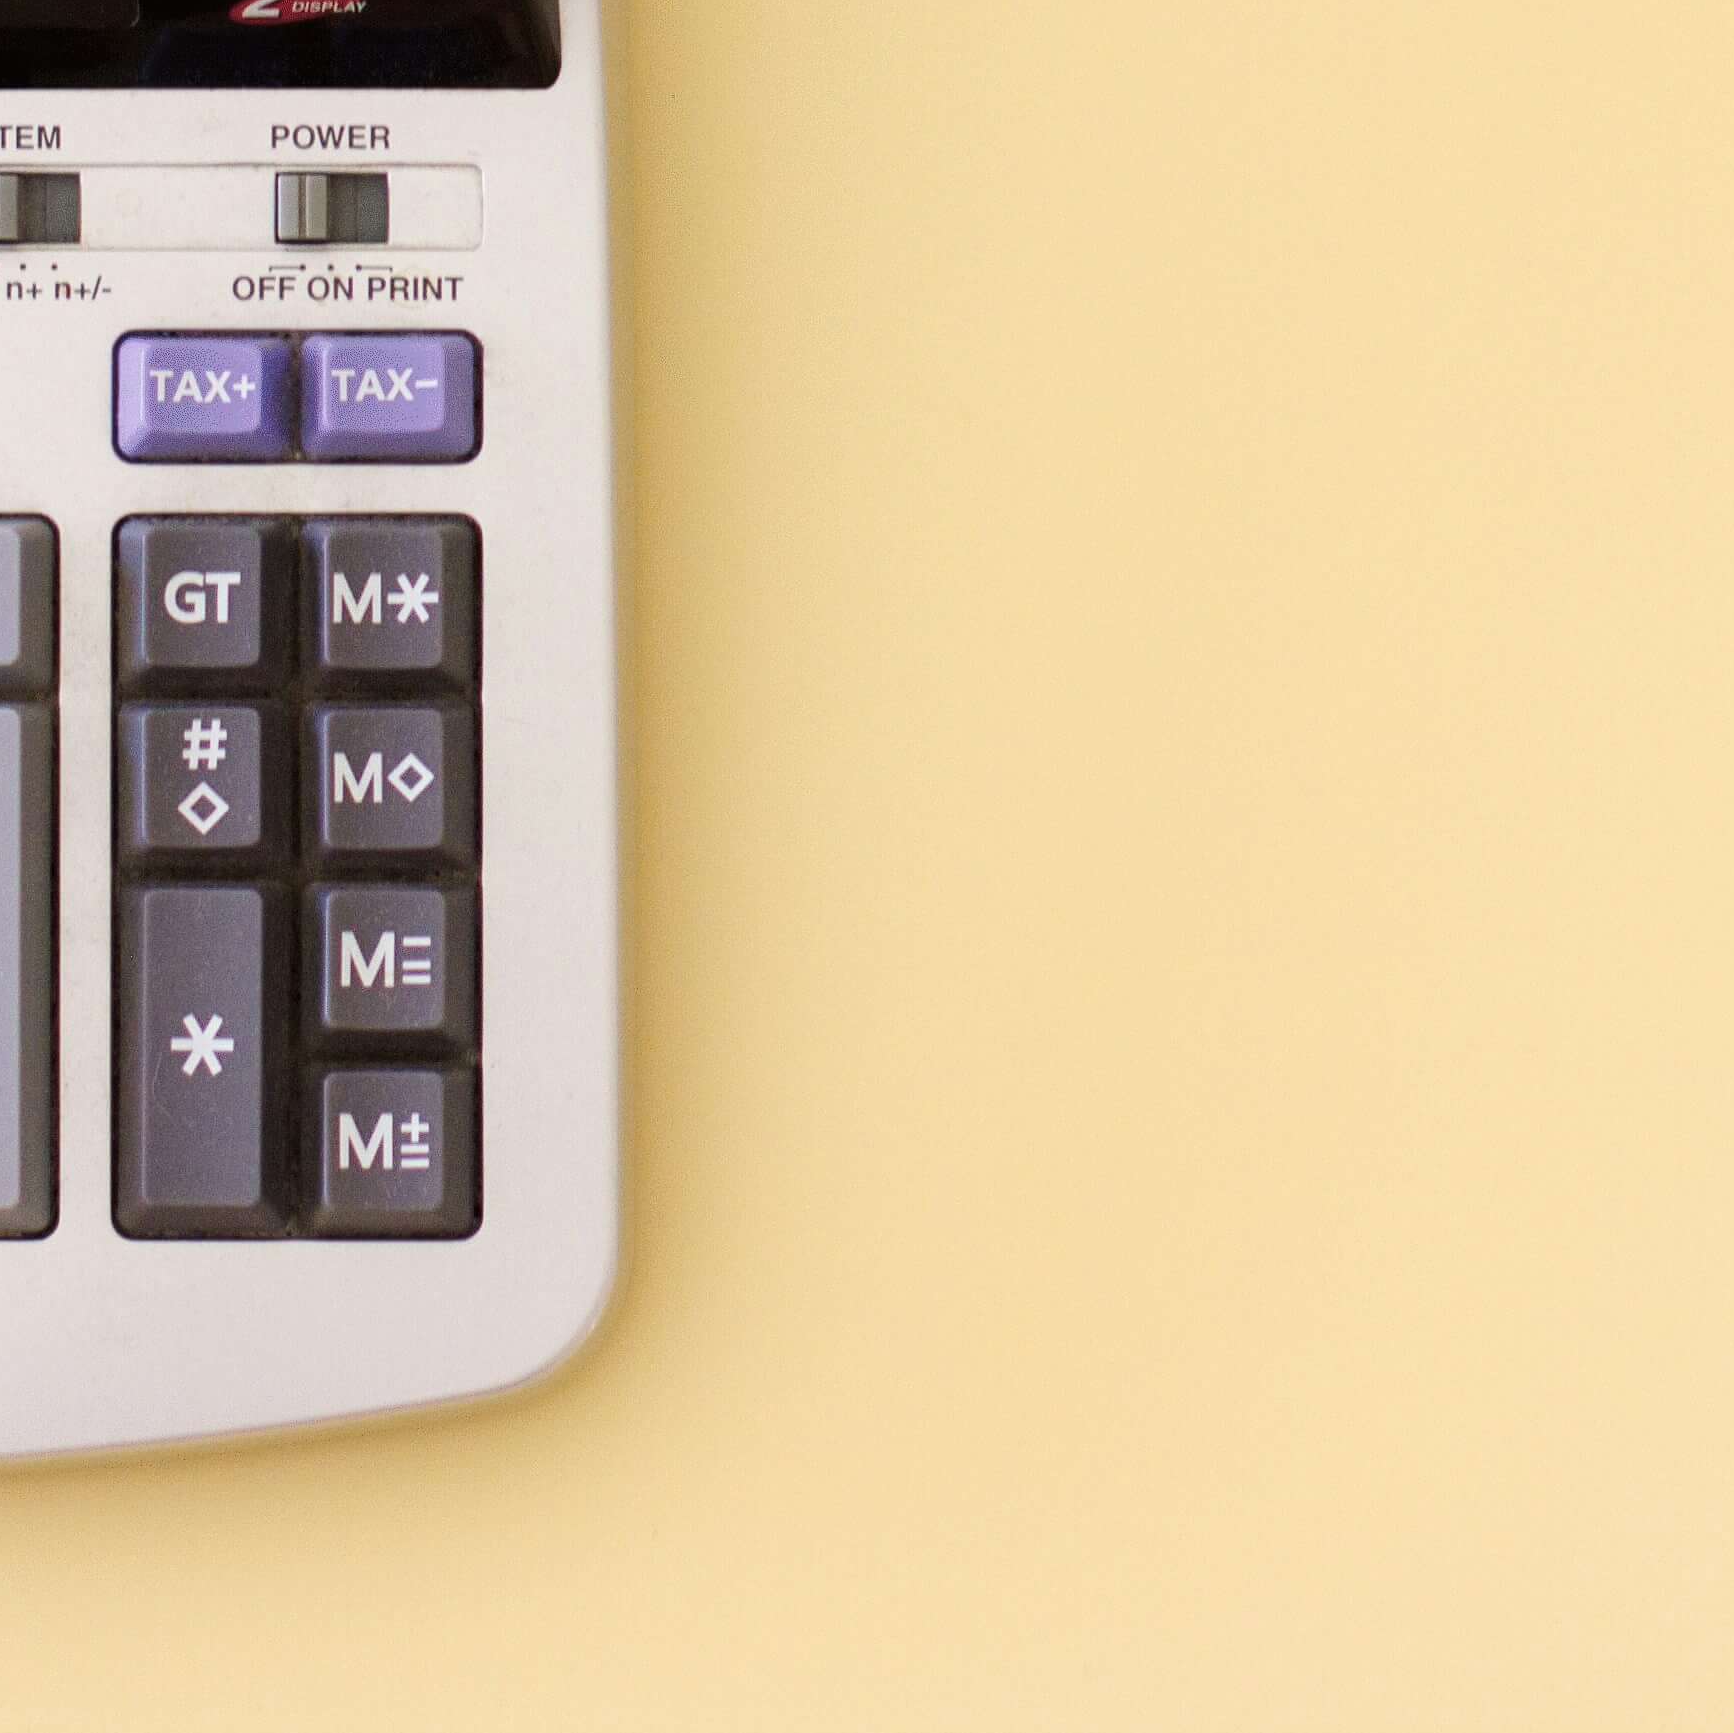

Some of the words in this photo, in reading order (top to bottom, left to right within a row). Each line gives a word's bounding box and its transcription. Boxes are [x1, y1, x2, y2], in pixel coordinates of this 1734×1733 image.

[291, 0, 367, 14] DISPLAY
[271, 125, 390, 150] POWER
[6, 281, 39, 300] n+
[232, 276, 296, 301] OFF
[307, 276, 354, 301] ON
[367, 276, 463, 301] PRINT
[149, 369, 257, 404] TAX+
[164, 571, 242, 624] GT
